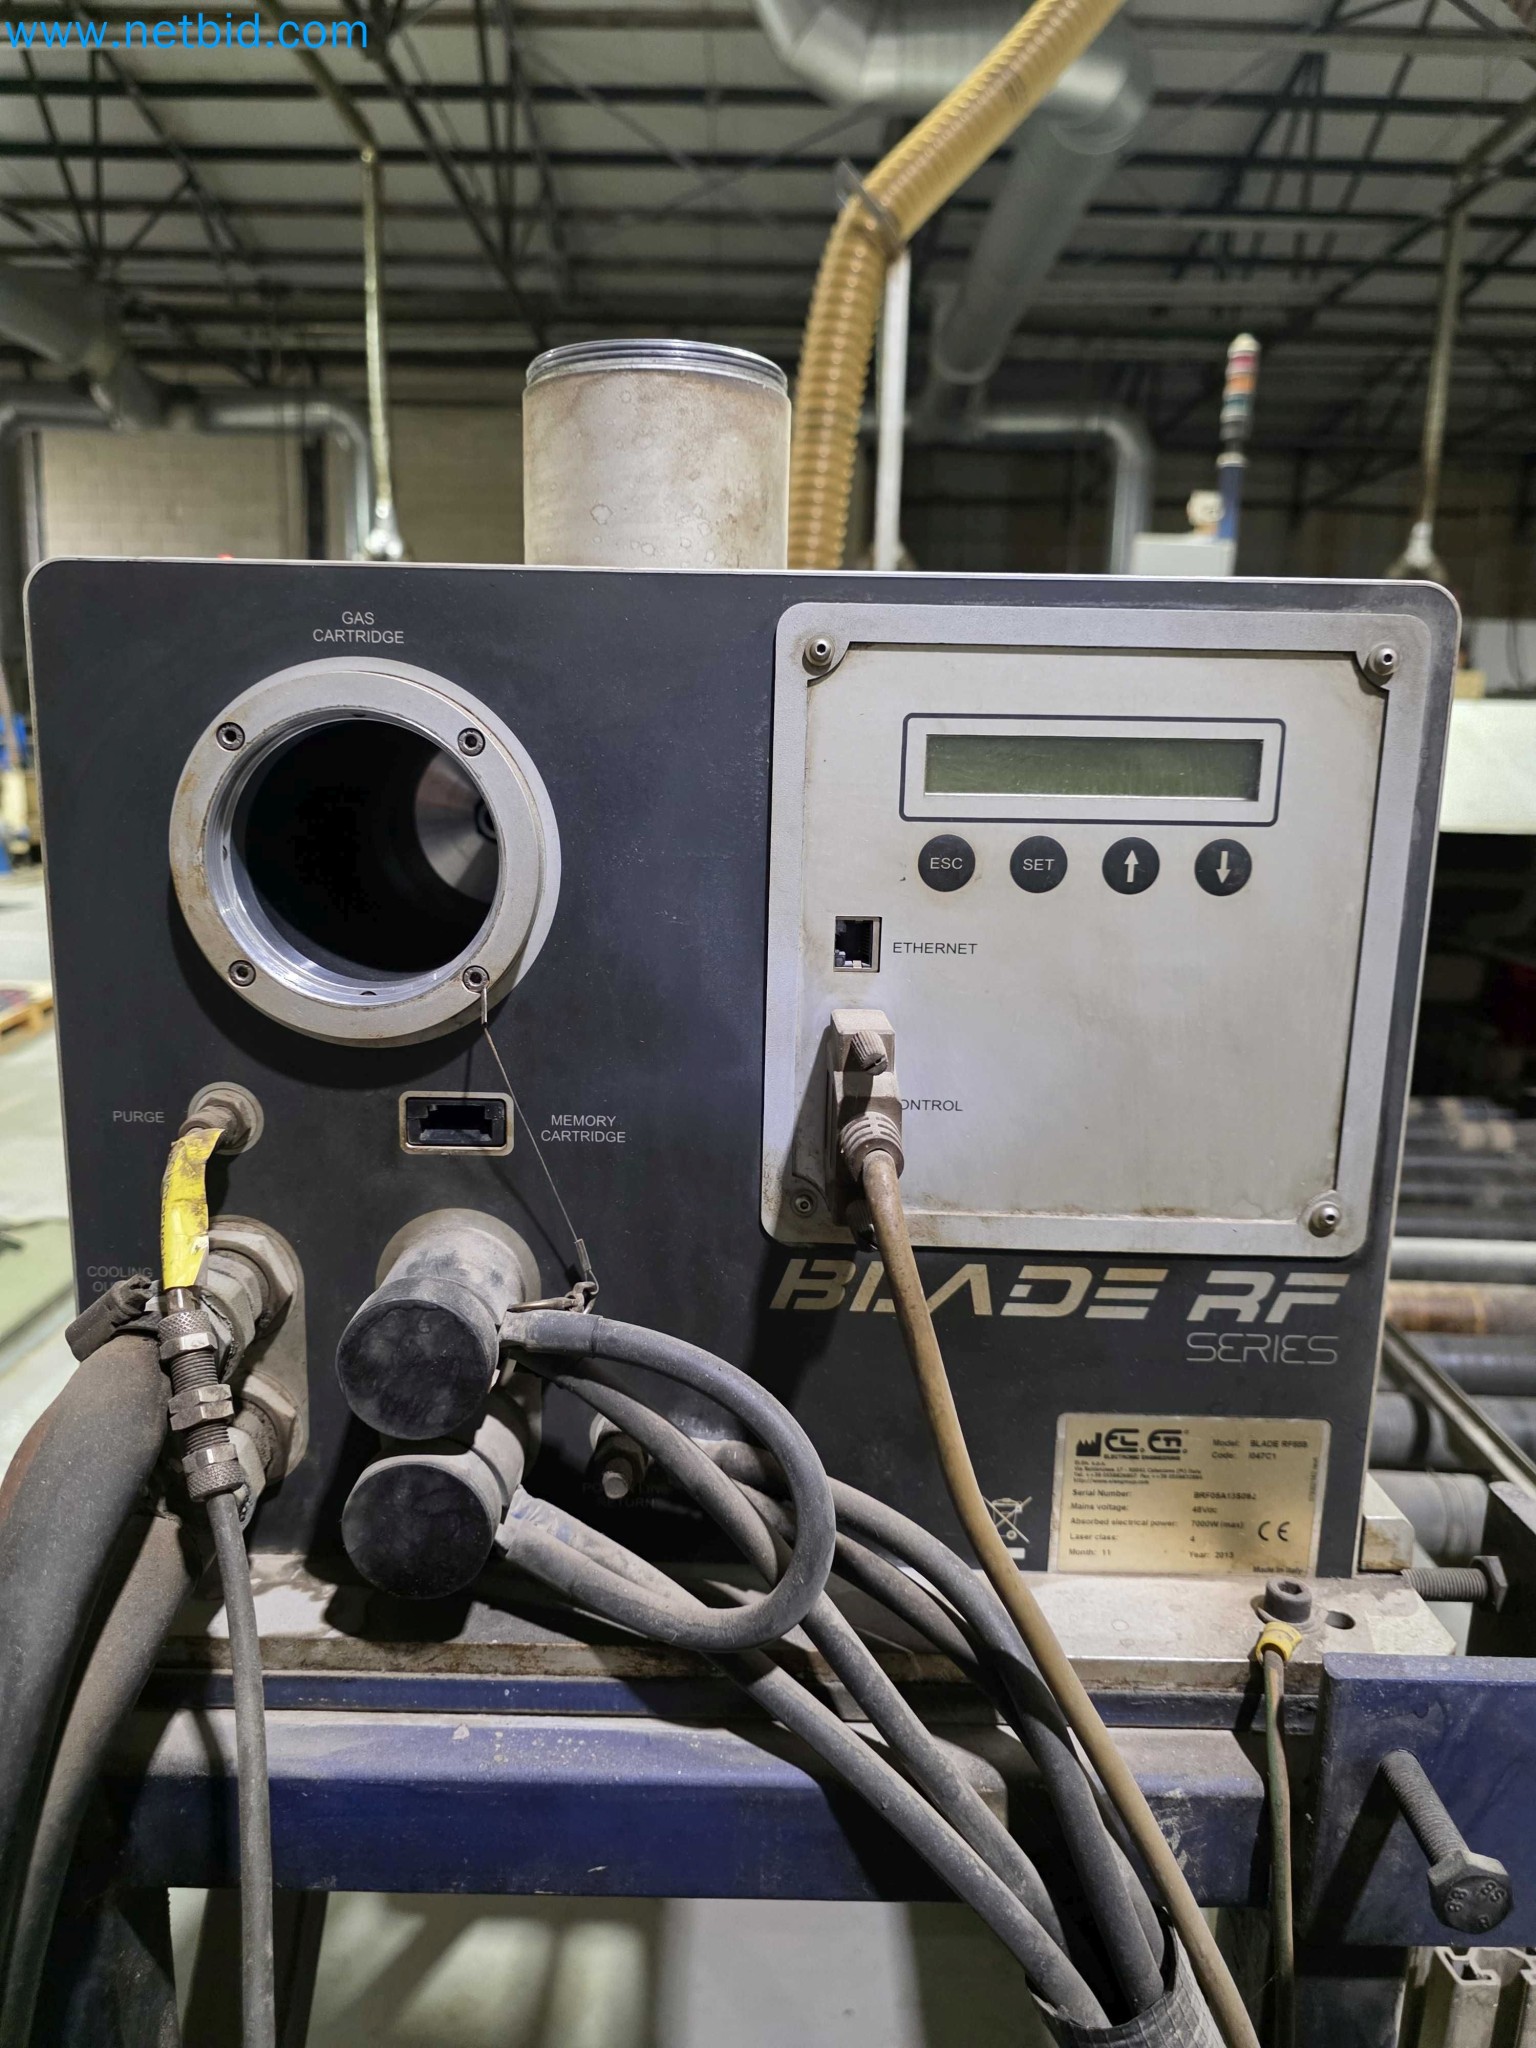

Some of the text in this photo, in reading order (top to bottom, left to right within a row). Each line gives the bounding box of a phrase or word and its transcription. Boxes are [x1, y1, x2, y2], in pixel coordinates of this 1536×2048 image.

[341, 611, 375, 625] GAS
[312, 629, 405, 644] CARTRIDGE
[929, 857, 963, 870] ESC
[1022, 858, 1056, 871] SET
[892, 941, 979, 955] ETHERNET
[901, 1098, 963, 1112] ONTROL
[112, 1110, 166, 1123] PURGE
[551, 1114, 617, 1127] MEMORY
[540, 1129, 626, 1143] CARTRIDGE
[769, 1258, 1350, 1324] BLADE RF
[1186, 1331, 1340, 1365] SERIES
[1249, 1439, 1279, 1448] BLADE
[1072, 1488, 1095, 1497] Serial
[1097, 1489, 1132, 1498] Number:
[1071, 1502, 1095, 1510] Mains
[1097, 1503, 1129, 1512] voltage:
[1070, 1517, 1109, 1526] Absorbed
[1111, 1518, 1148, 1526] electrical
[1150, 1519, 1178, 1528] power:
[1069, 1532, 1093, 1541] Laser
[1094, 1533, 1118, 1541] class:
[1068, 1548, 1096, 1556] Month:
